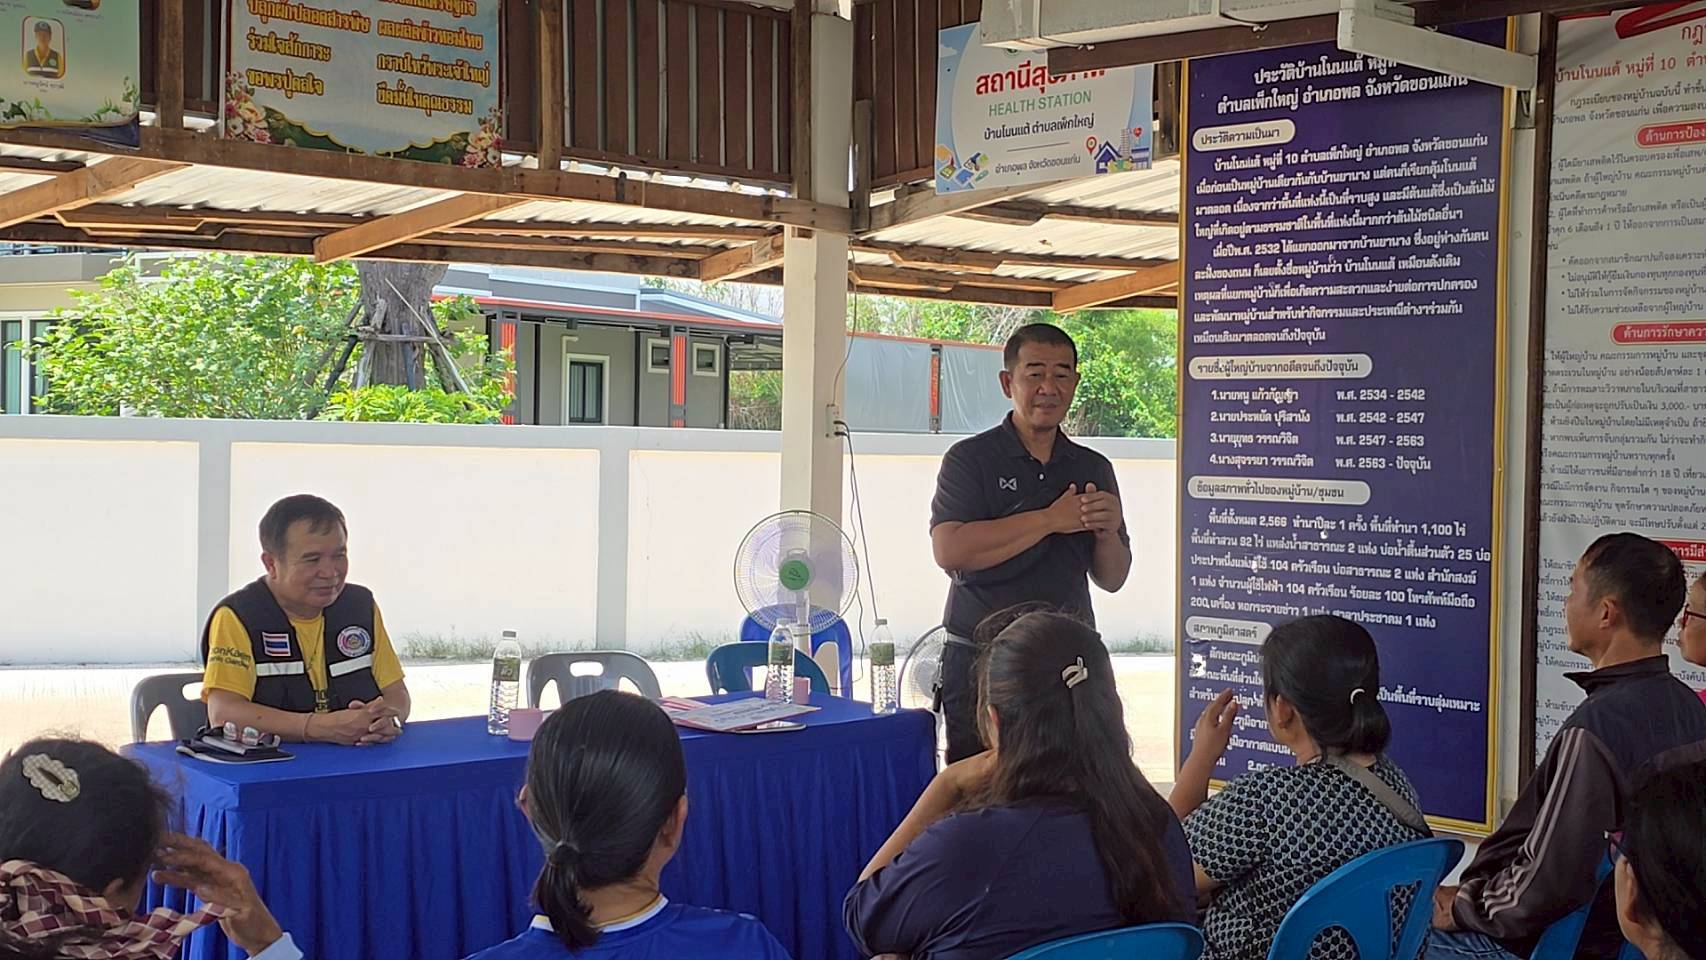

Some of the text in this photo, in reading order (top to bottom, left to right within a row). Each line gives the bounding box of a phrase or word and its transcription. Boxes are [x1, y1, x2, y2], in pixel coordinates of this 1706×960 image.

[247, 27, 490, 88] ร่วมใจสักการะ กราบไหว้พระเจ้าใหญ่
[1254, 54, 1363, 84] ประวัติบ้านโนนแต้
[1555, 59, 1622, 83] บ้านโนนแต้
[1625, 53, 1654, 79] หมู่ที่
[1660, 57, 1676, 71] 10
[975, 60, 1105, 95] สถานีสุ
[377, 79, 472, 117] ยึดมั่นในคุณธรรม
[989, 90, 1092, 117] HEALTH STATION
[1217, 74, 1468, 114] ตำบลเพ็กใหญ่ อำเภอพล จังหวัดขอนแกน
[1589, 105, 1649, 121] จังหวัดขอนแก่น
[984, 112, 1095, 141] บ้านโนนแต้ ตำบลเพ็กใหญ่
[1200, 127, 1280, 145] ประวัติความเป็นมา
[995, 152, 1080, 174] อำเภอพล จังหวัดขอนแก่น
[1214, 132, 1488, 171] บ้านโนนแต้ หมู่ที่ 10 ตำบลเพ็กใหญ่ อำเภอพล จังหวัดขอนแก่น
[1195, 204, 1231, 216] มาตลอด
[1567, 226, 1573, 234] 6
[1606, 223, 1611, 231] 1
[1255, 243, 1280, 255] 2532
[1345, 256, 1395, 272] บ้านโนนแต้
[1336, 389, 1357, 401] พ.ศ.
[1360, 389, 1387, 400] 2534
[1399, 389, 1426, 401] 2542
[1336, 412, 1357, 424] พ.ศ.
[1359, 412, 1387, 424] 2542
[1399, 412, 1425, 424] 2547
[1336, 435, 1356, 447] พ.ศ.
[1358, 435, 1386, 446] 2547
[1396, 435, 1425, 447] 2563
[1335, 457, 1356, 469] พ.ศ.
[1358, 457, 1386, 469] 2563
[1396, 455, 1431, 474] ปัจจุบัน
[1259, 515, 1287, 528] 2,566
[1339, 520, 1345, 530] 1
[1348, 514, 1367, 532] ครั้ง
[1370, 515, 1418, 534] พื้นที่ทำนา
[1421, 523, 1452, 536] 1,100
[1454, 521, 1466, 537] ไร่
[1253, 534, 1264, 548] ไร่
[1266, 533, 1345, 553] แหล่งน้ำสาธารณะ
[1348, 543, 1355, 553] 2
[1358, 542, 1377, 555] แห่ง
[1458, 549, 1472, 560] 25
[1475, 548, 1490, 562] บ่อ
[1270, 560, 1288, 571] 104
[1291, 559, 1330, 574] ครัวเรือน
[1332, 562, 1391, 578] บ่อสาธารณะ
[1394, 569, 1402, 579] 2
[1405, 568, 1425, 581] แห่ง
[1427, 569, 1477, 585] สำนักสงฆ์
[1191, 576, 1196, 586] 1
[1200, 576, 1216, 587] แห่ง
[1286, 583, 1305, 594] 104
[1307, 583, 1347, 598] ครัวเรือน
[1350, 585, 1381, 600] ร้อยละ
[1385, 591, 1405, 602] 100
[1407, 588, 1476, 608] โทรศัพท์มือถือ
[1238, 602, 1299, 616] หอกระจายข่าว
[1302, 606, 1308, 617] 1
[1406, 615, 1412, 626] 1
[1416, 614, 1436, 628] แห่ง
